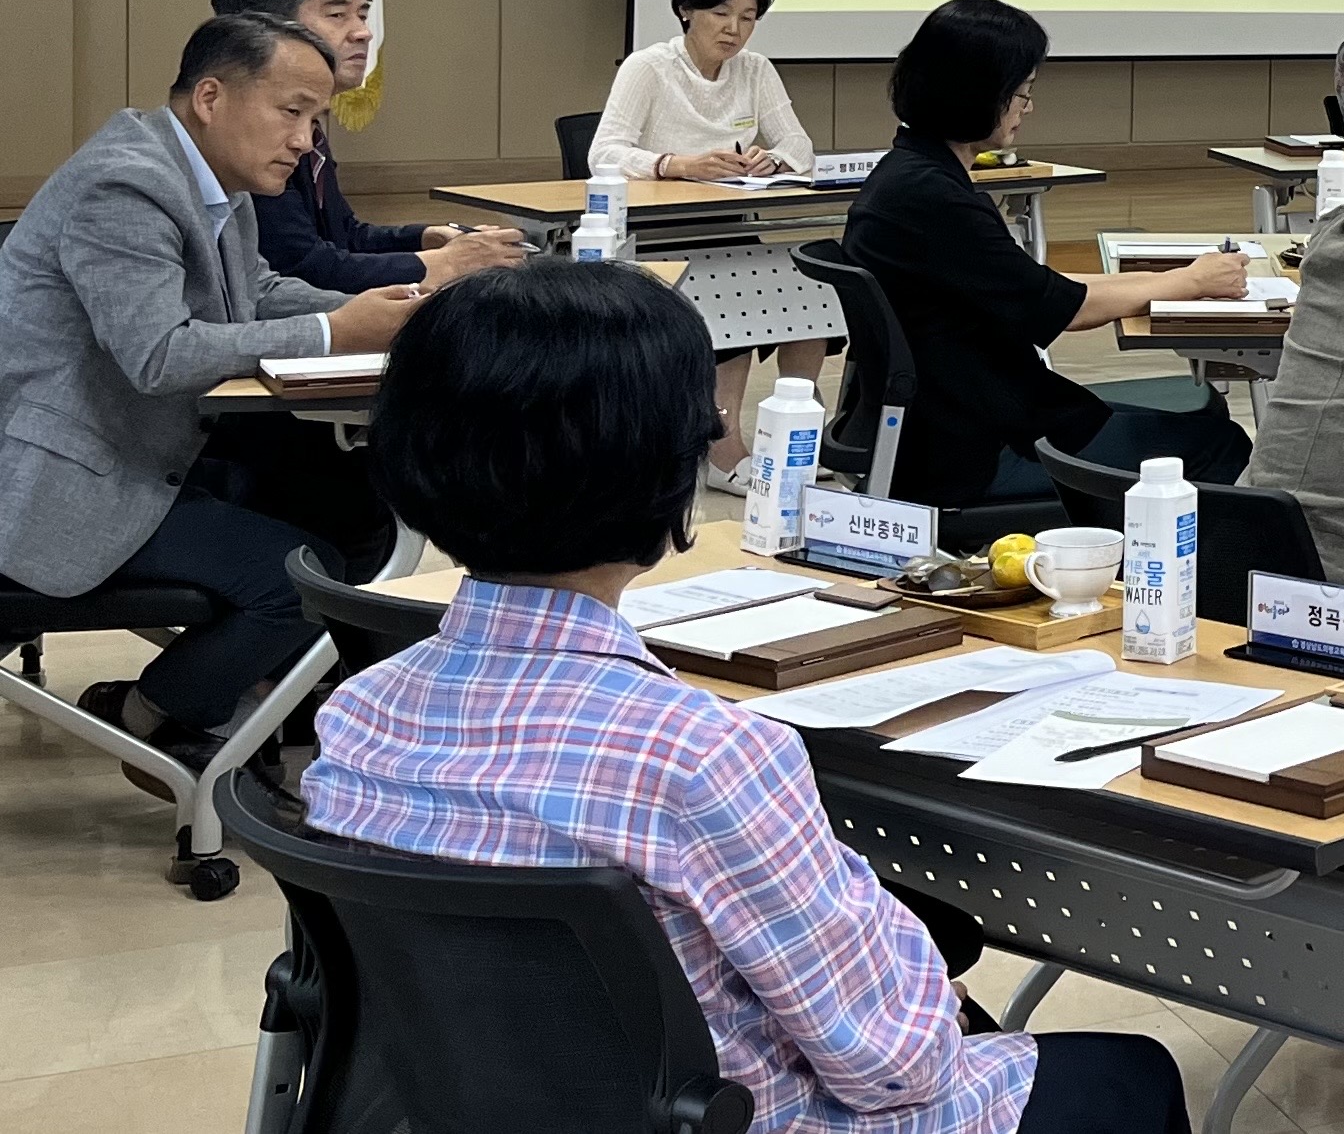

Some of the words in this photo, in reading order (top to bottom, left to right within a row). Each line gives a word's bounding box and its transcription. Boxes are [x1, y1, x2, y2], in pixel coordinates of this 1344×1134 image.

[839, 161, 879, 174] 행정지원
[848, 514, 919, 545] 신반중학교
[1144, 560, 1166, 588] 물
[1125, 587, 1163, 606] WATER
